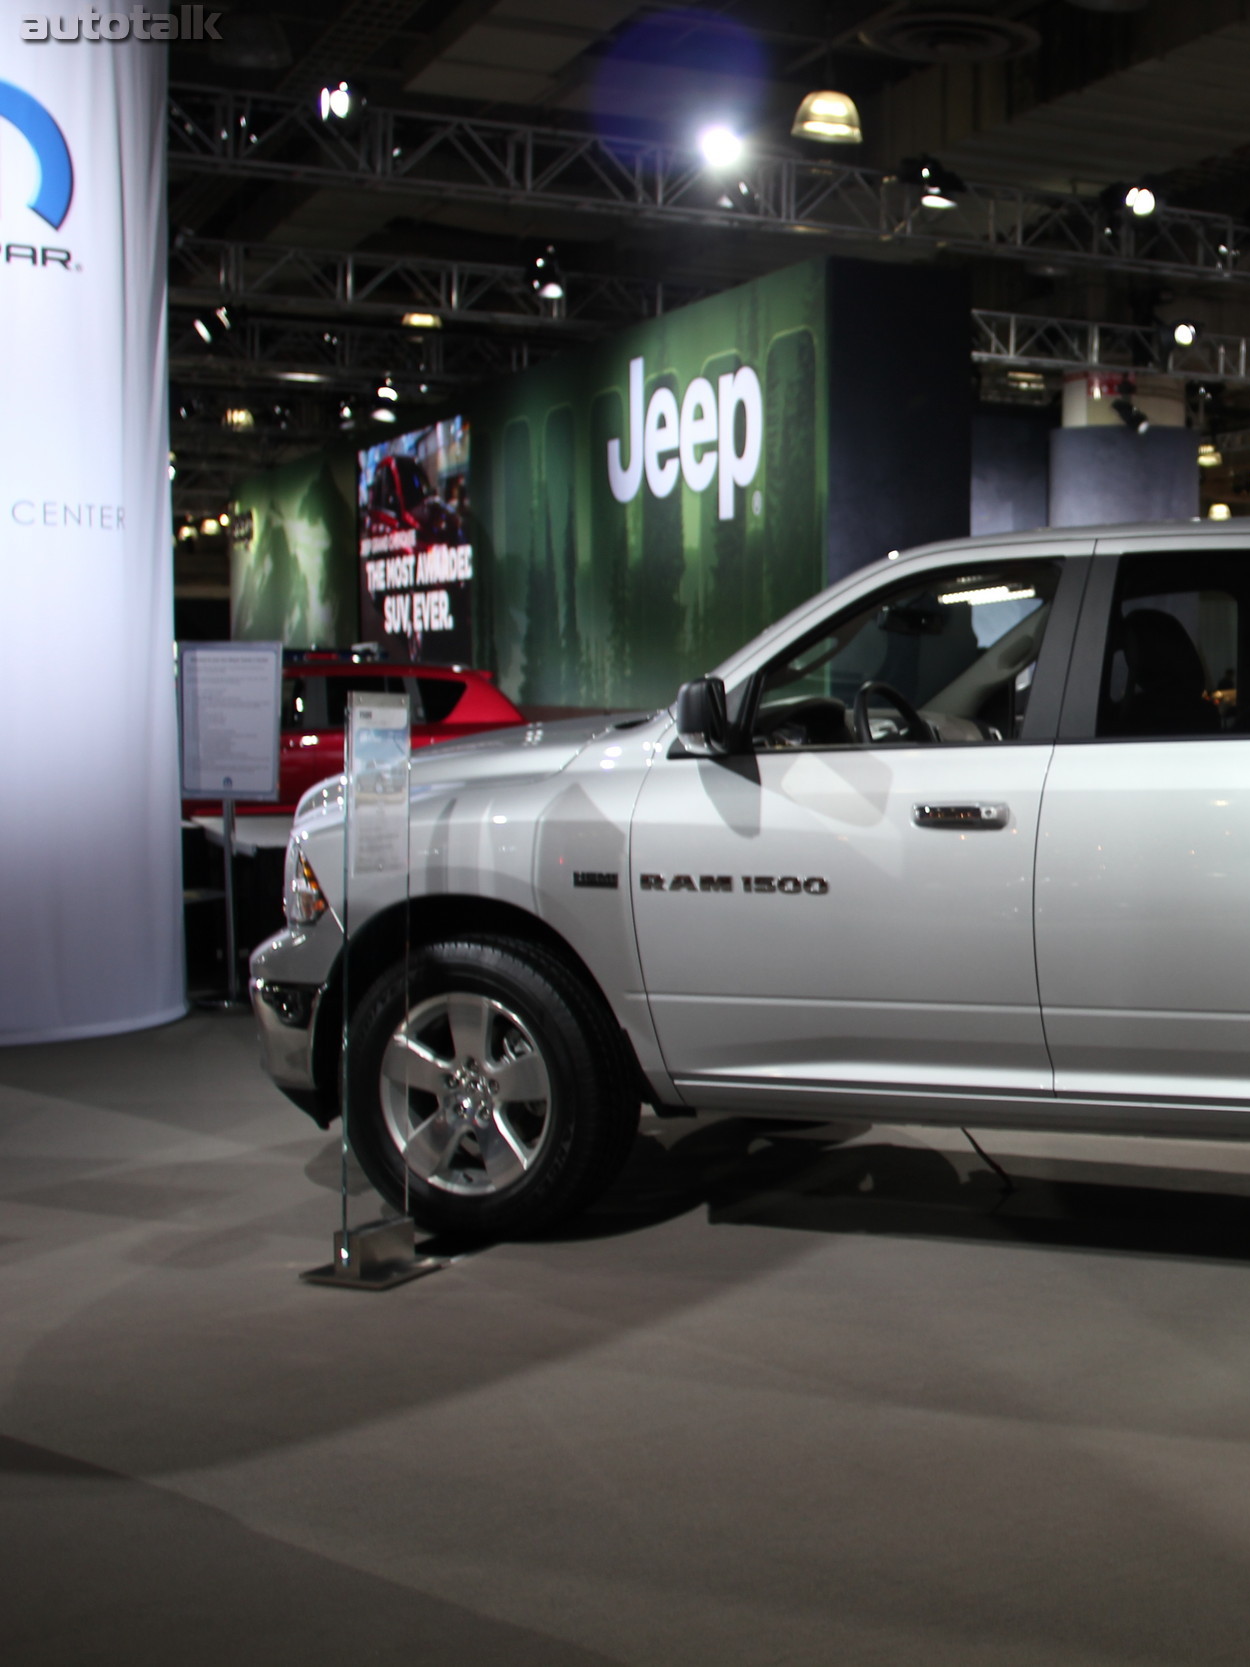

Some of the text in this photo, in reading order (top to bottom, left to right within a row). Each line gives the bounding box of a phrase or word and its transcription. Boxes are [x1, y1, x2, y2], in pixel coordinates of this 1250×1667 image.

[0, 243, 72, 271] AR
[607, 356, 763, 520] Jeep
[11, 500, 126, 530] CENTER
[366, 560, 386, 592] THE
[386, 555, 415, 589] MOST
[413, 590, 454, 631] EVER.
[640, 873, 733, 892] RAM
[741, 875, 829, 895] 1500
